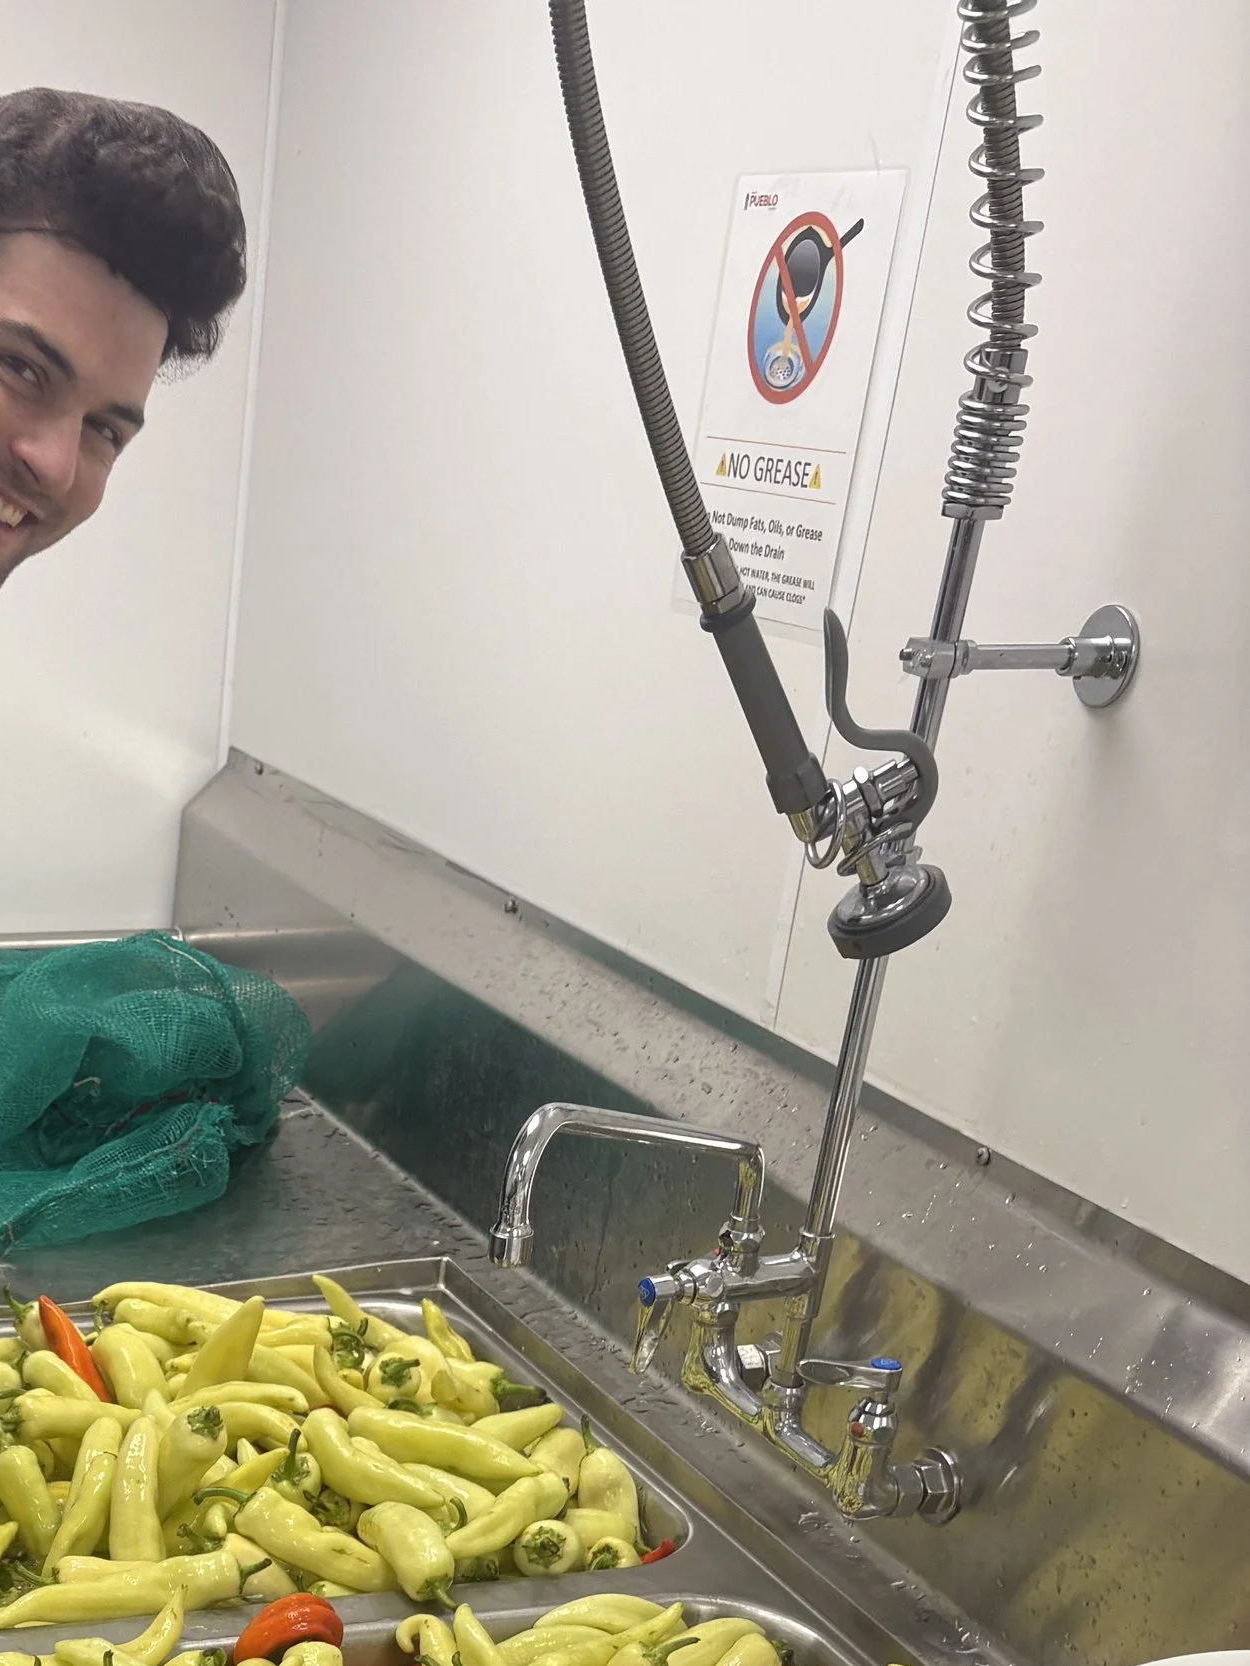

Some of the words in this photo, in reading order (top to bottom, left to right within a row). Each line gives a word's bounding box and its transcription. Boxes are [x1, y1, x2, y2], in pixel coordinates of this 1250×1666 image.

[749, 194, 778, 207] PUEBLO
[727, 452, 750, 479] NO
[754, 457, 812, 488] GREASE
[712, 511, 726, 525] Not
[727, 513, 749, 531] Dump
[749, 516, 767, 534] Fats,
[768, 519, 784, 537] Oils,
[785, 526, 795, 537] or
[796, 524, 823, 541] Grease
[728, 537, 750, 554] Down
[750, 541, 763, 557] the
[764, 544, 785, 560] Drain
[781, 574, 802, 588] GREASE
[802, 578, 815, 591] WILL
[756, 586, 768, 598] CAN
[768, 588, 785, 601] CAUSE
